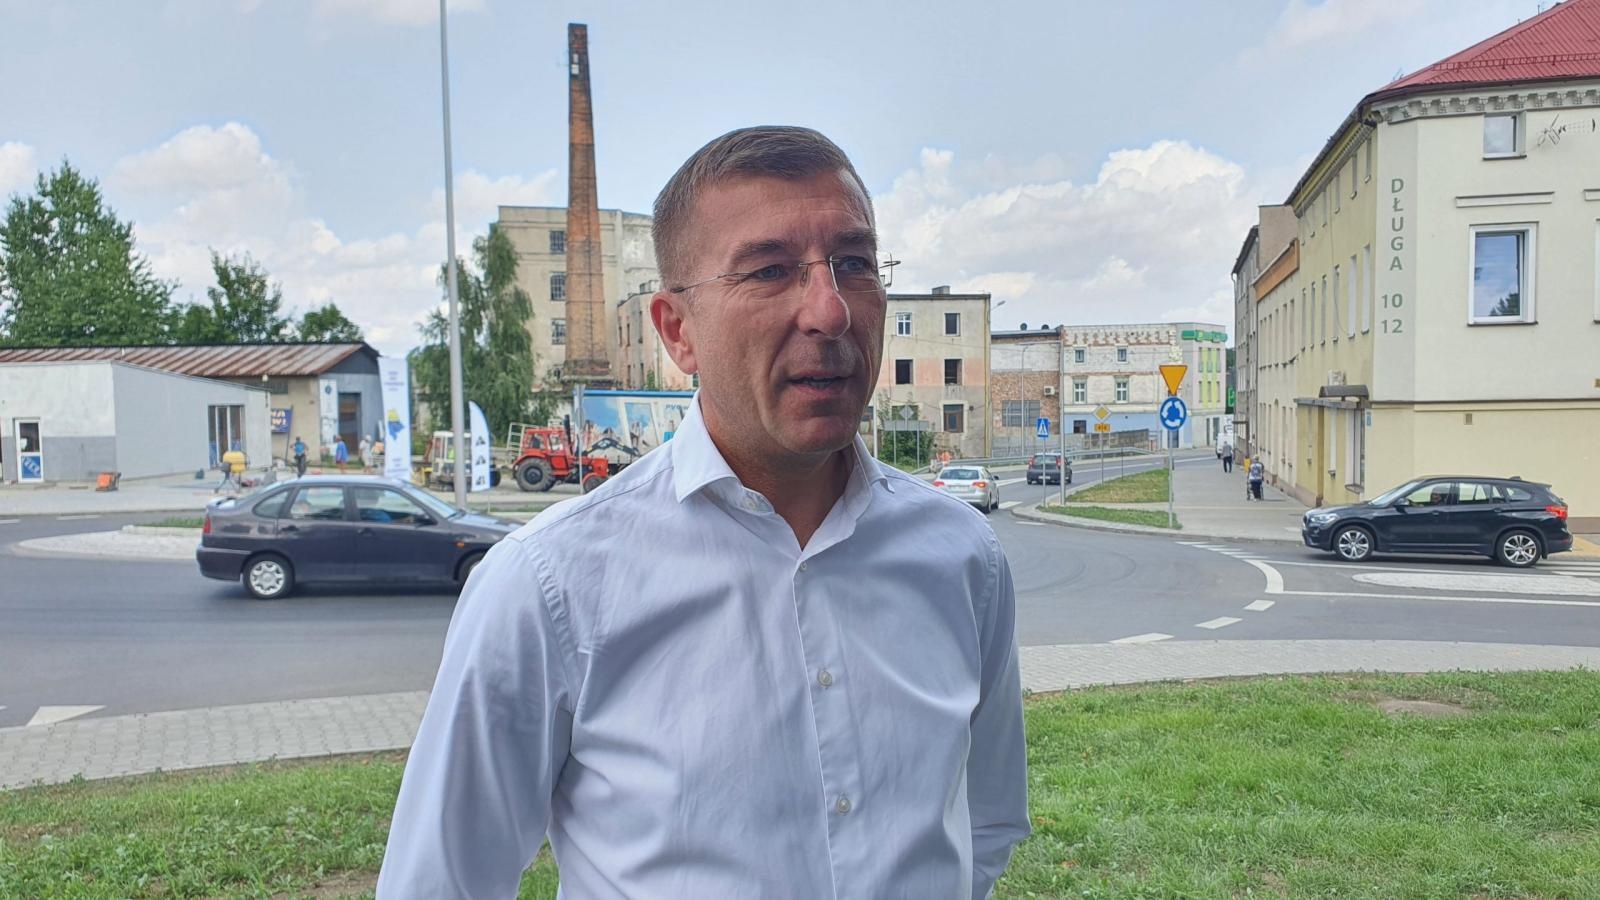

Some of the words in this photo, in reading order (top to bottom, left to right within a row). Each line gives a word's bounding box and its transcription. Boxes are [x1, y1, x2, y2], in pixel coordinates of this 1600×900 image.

[1389, 179, 1404, 271] DŁUGA
[1381, 293, 1403, 309] 10
[1381, 319, 1403, 334] 12
